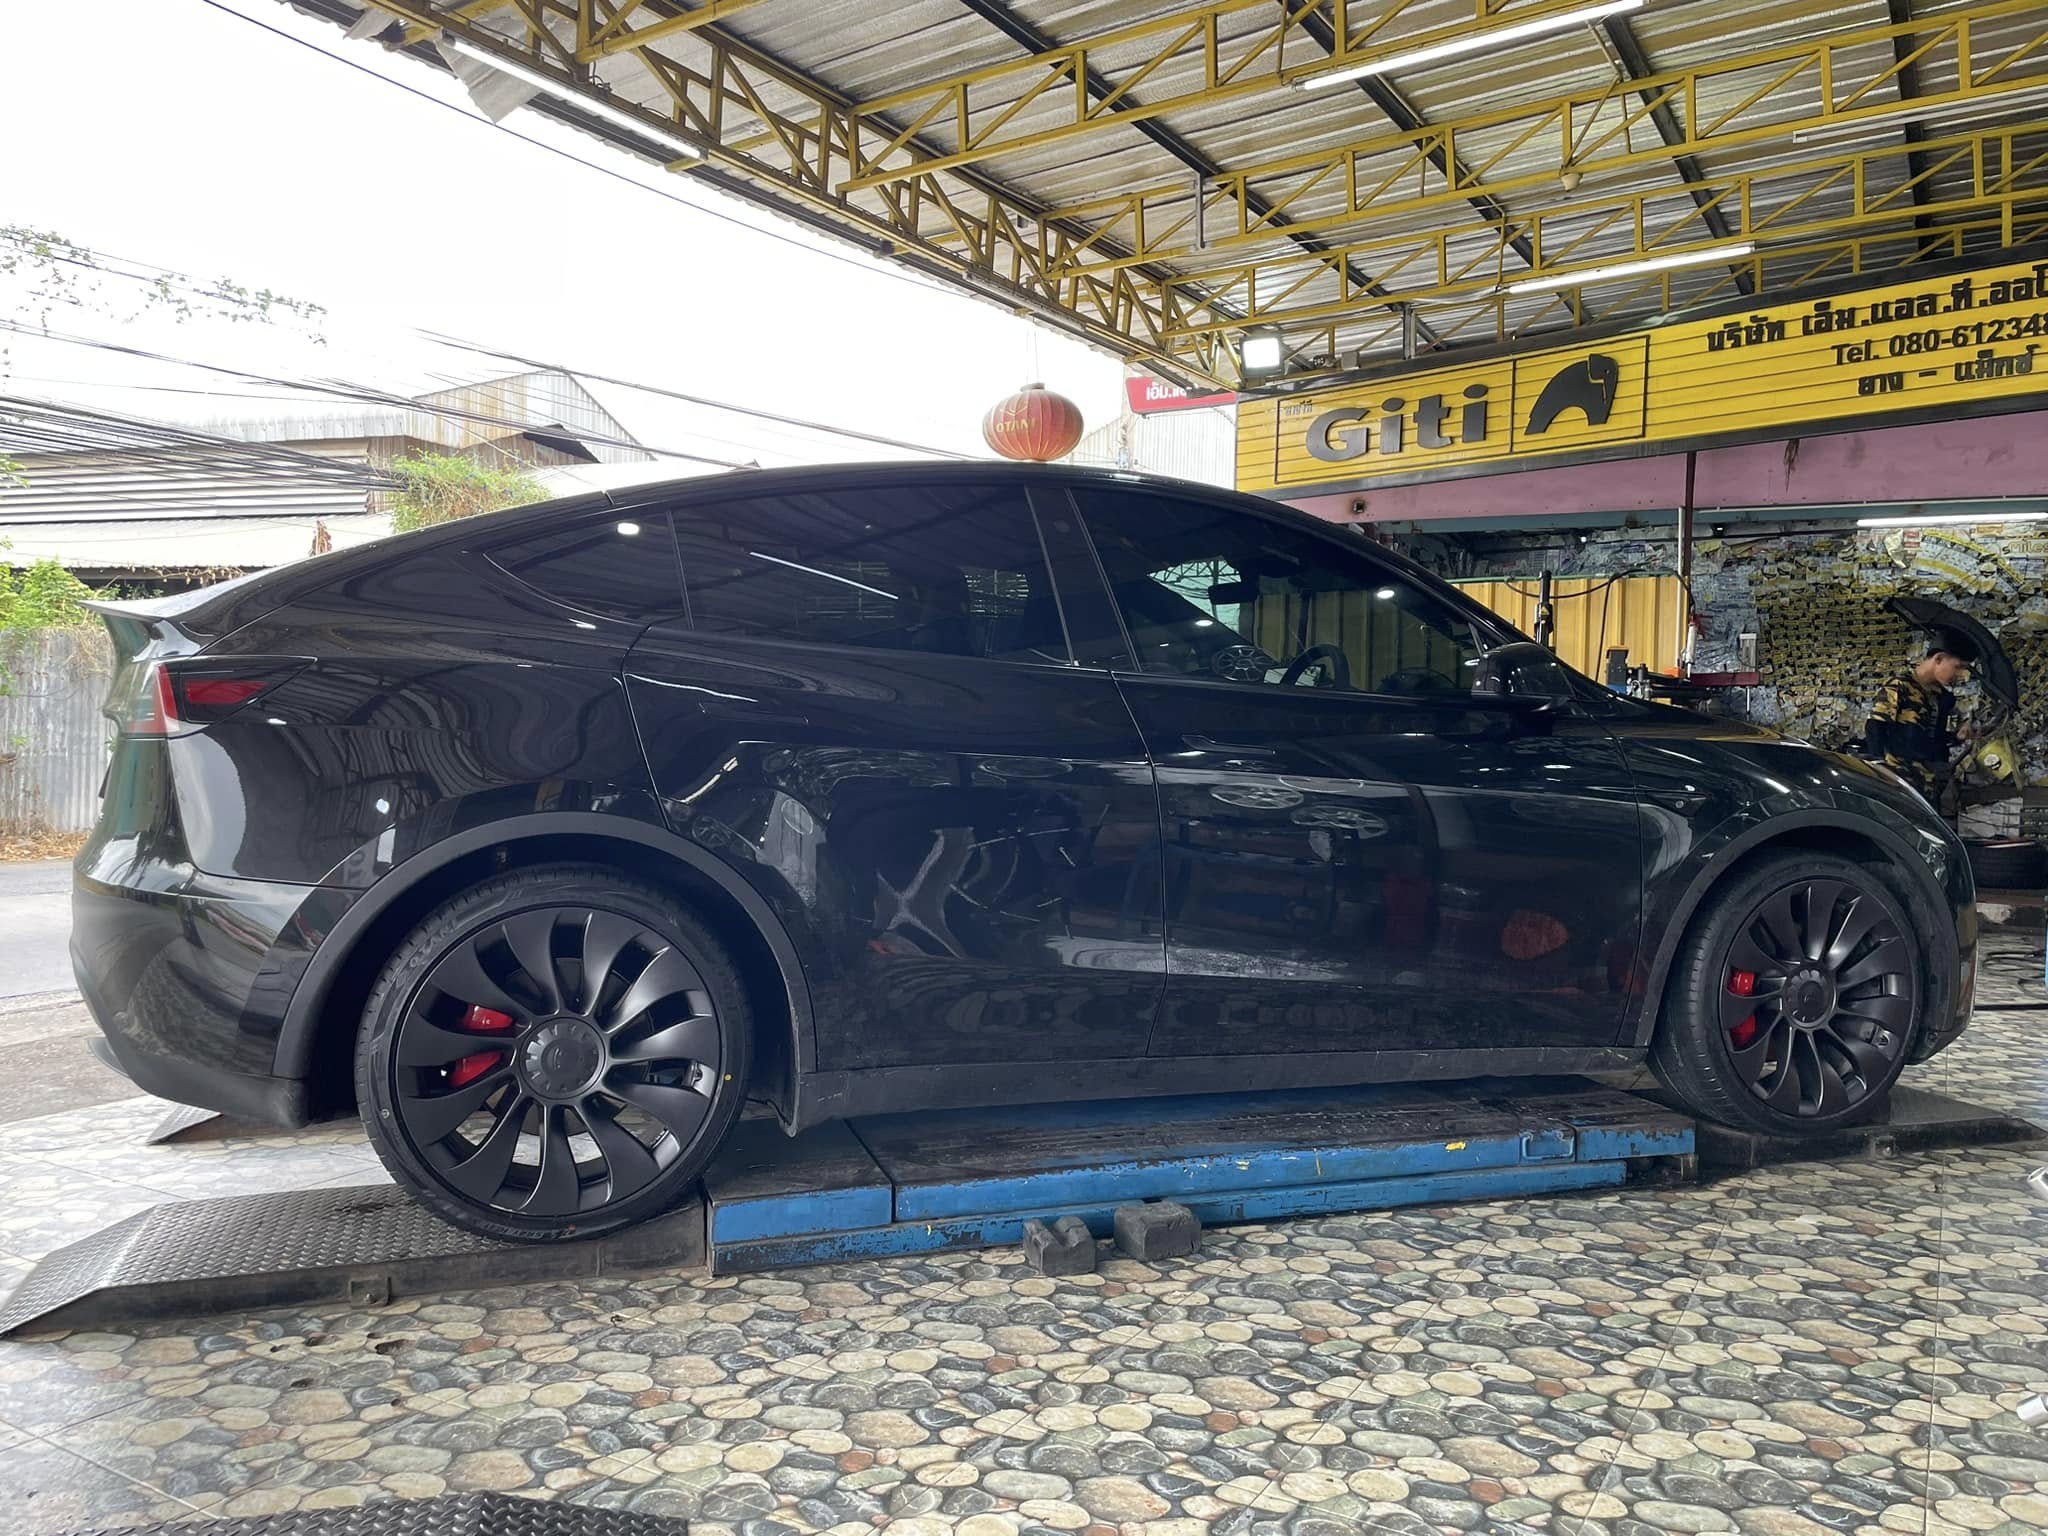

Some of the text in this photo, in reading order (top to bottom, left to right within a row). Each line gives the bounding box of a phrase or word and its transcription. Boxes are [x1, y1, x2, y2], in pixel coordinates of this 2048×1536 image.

[1707, 315, 1785, 352] บริษัท
[1831, 339, 1879, 366] Tel.
[1857, 371, 1904, 396] ยาง
[1305, 384, 1489, 463] Giti
